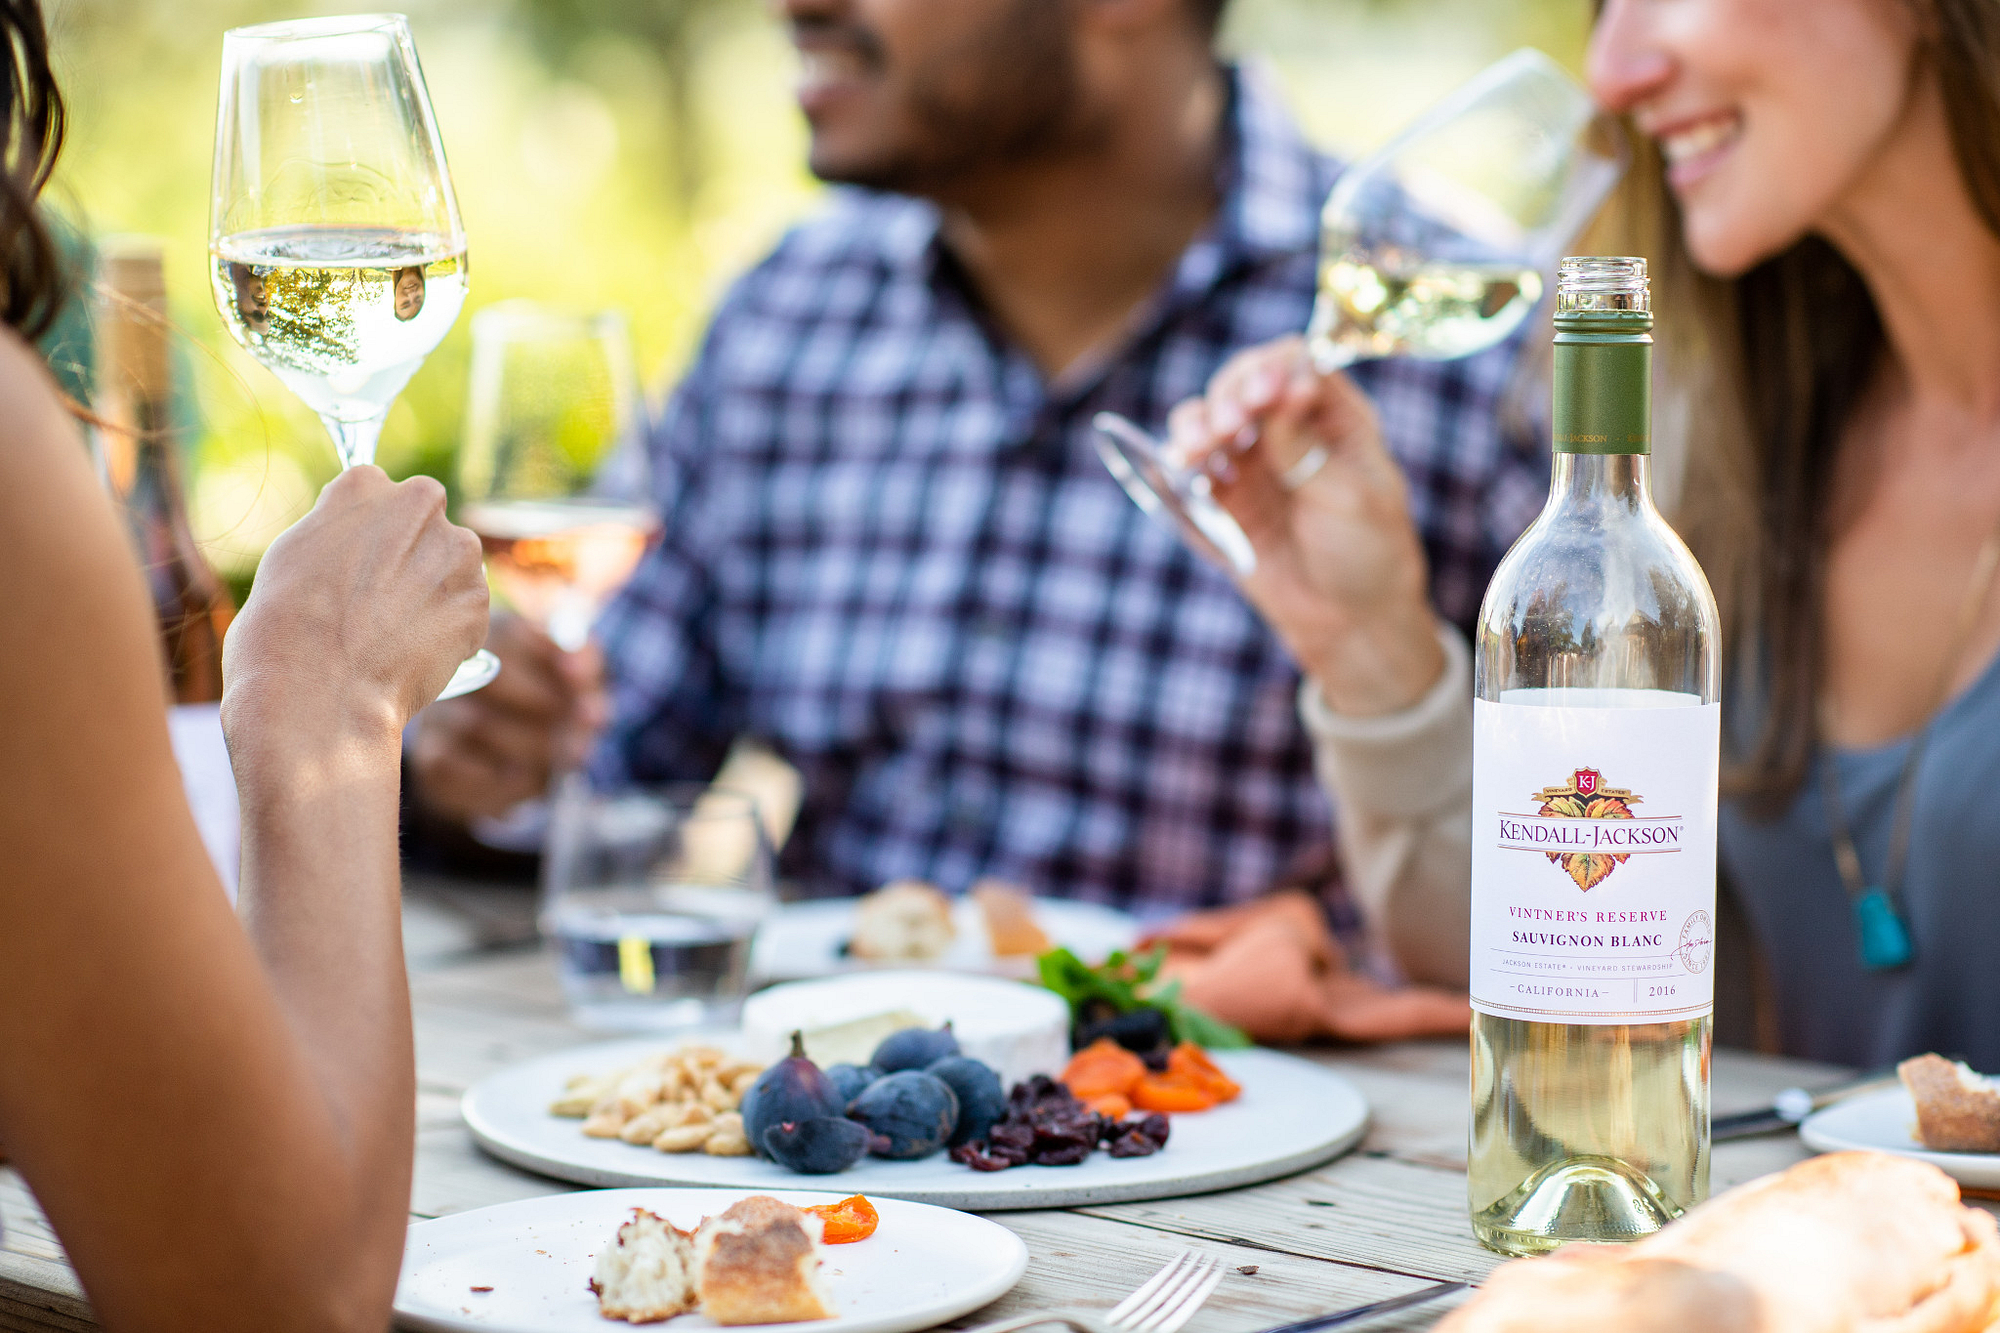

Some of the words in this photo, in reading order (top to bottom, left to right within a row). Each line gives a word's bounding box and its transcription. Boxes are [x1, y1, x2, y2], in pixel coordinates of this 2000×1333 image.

[1569, 432, 1608, 443] JACKSON
[1578, 775, 1596, 790] K-J
[1509, 906, 1588, 922] VINTNER'S
[1596, 910, 1668, 923] RESERVE
[1512, 930, 1605, 947] SAUVIGNON
[1610, 934, 1662, 947] BLANC
[1502, 959, 1531, 968] JACKSON
[1577, 964, 1618, 972] VINEYARD
[1621, 963, 1674, 972] STEWARDSHIP
[1649, 984, 1676, 997] 2016
